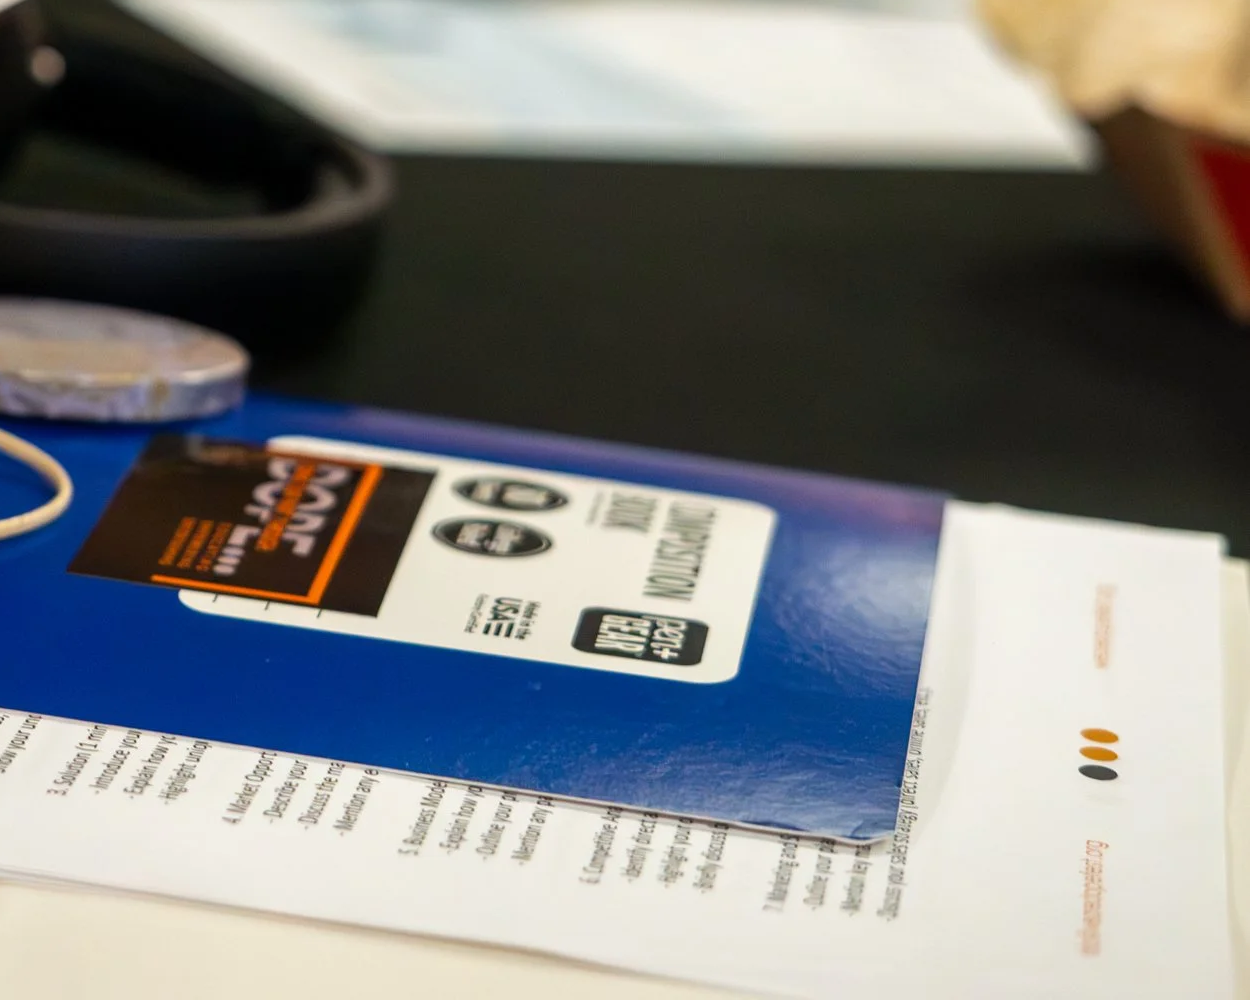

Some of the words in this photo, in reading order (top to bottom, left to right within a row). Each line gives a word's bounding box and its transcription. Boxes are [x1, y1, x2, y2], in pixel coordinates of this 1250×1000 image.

[488, 597, 524, 622] USA
[594, 614, 651, 653] GEAR
[7, 730, 31, 750] your
[53, 752, 91, 787] Solution
[88, 749, 130, 790] Introduce
[123, 765, 158, 796] Explain
[141, 744, 169, 765] how
[157, 763, 197, 800] Highlight
[226, 783, 261, 814] Market
[263, 781, 299, 818] Describe
[287, 760, 309, 780] your
[298, 793, 330, 825] Discuss
[315, 777, 338, 792] the
[332, 794, 367, 831] Mention
[356, 776, 380, 793] any
[451, 797, 478, 818] how
[402, 809, 437, 846] Business
[438, 819, 470, 850] Explain
[475, 825, 505, 855] Outline
[492, 801, 513, 823] your
[511, 824, 543, 861] Mention
[529, 806, 554, 824] any
[630, 819, 658, 845] direct
[672, 825, 692, 847] your
[892, 810, 919, 844] strategy
[582, 824, 618, 873] Competitive
[619, 846, 654, 878] Identify
[701, 830, 729, 861] discuss
[780, 841, 799, 860] and
[886, 844, 908, 866] sales
[658, 847, 688, 884] Highlight
[767, 862, 800, 902] Marketing
[814, 854, 835, 876] your
[846, 860, 873, 875] key
[887, 866, 908, 886] your
[803, 876, 830, 906] Outline
[839, 875, 866, 912] Mention
